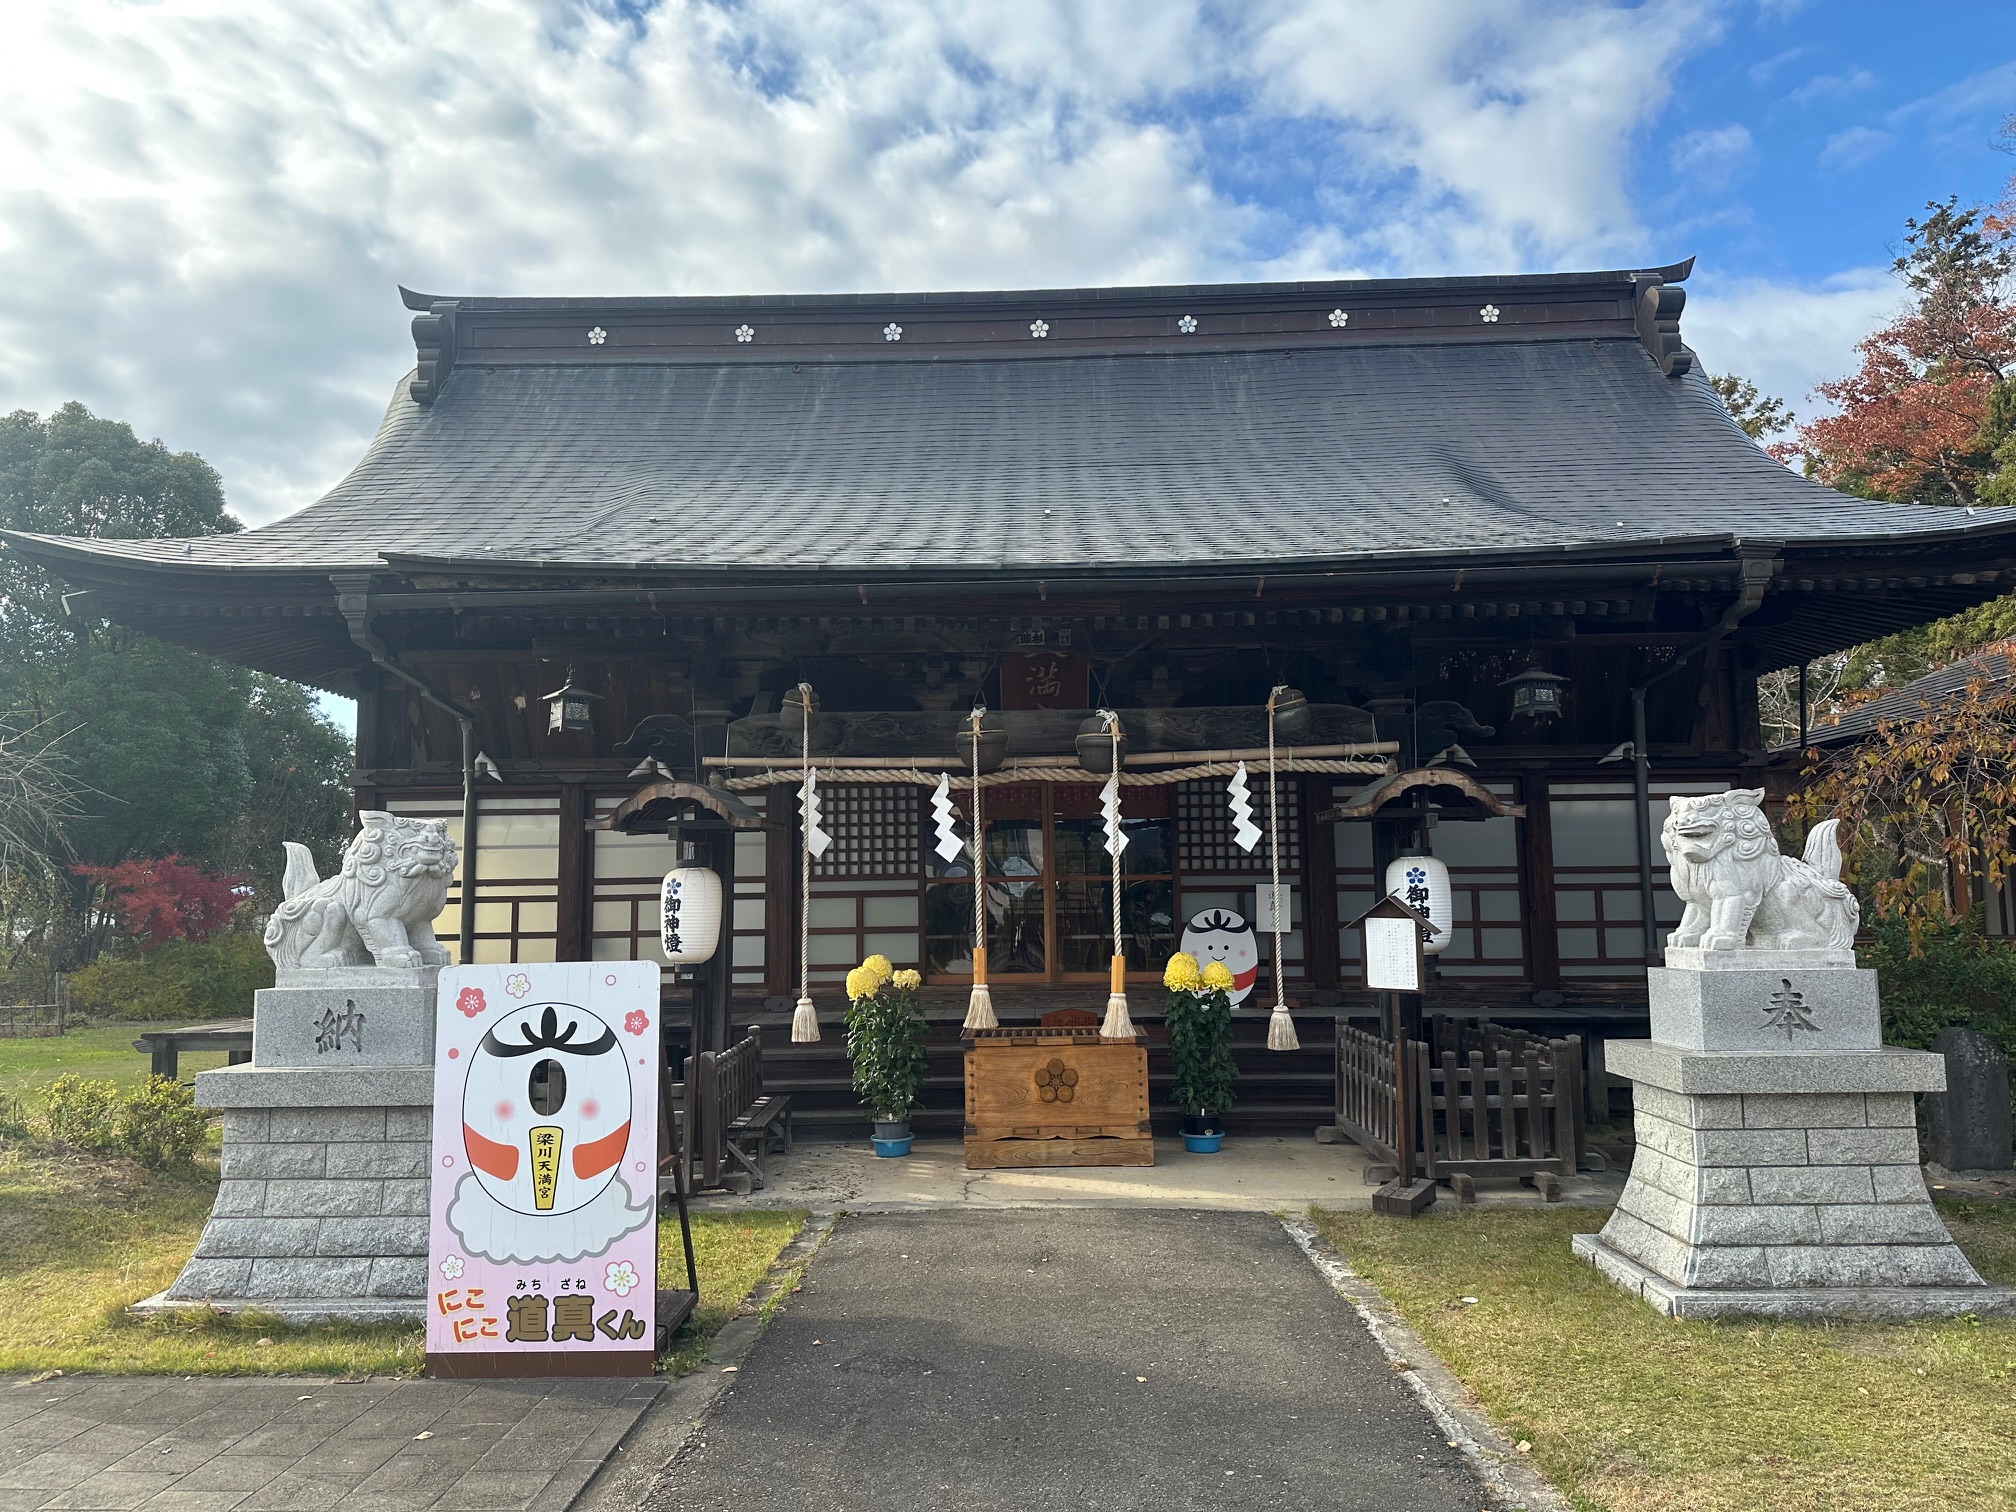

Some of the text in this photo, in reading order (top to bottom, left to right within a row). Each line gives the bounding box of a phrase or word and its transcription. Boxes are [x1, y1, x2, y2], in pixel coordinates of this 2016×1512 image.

[663, 895, 683, 953] 御神燈
[313, 999, 367, 1054] 納
[1759, 978, 1822, 1042] 奉
[536, 1133, 554, 1198] 梁川天満宮
[436, 1288, 485, 1315] にこ
[505, 1294, 646, 1342] 道真くん
[452, 1317, 499, 1343] にこ
